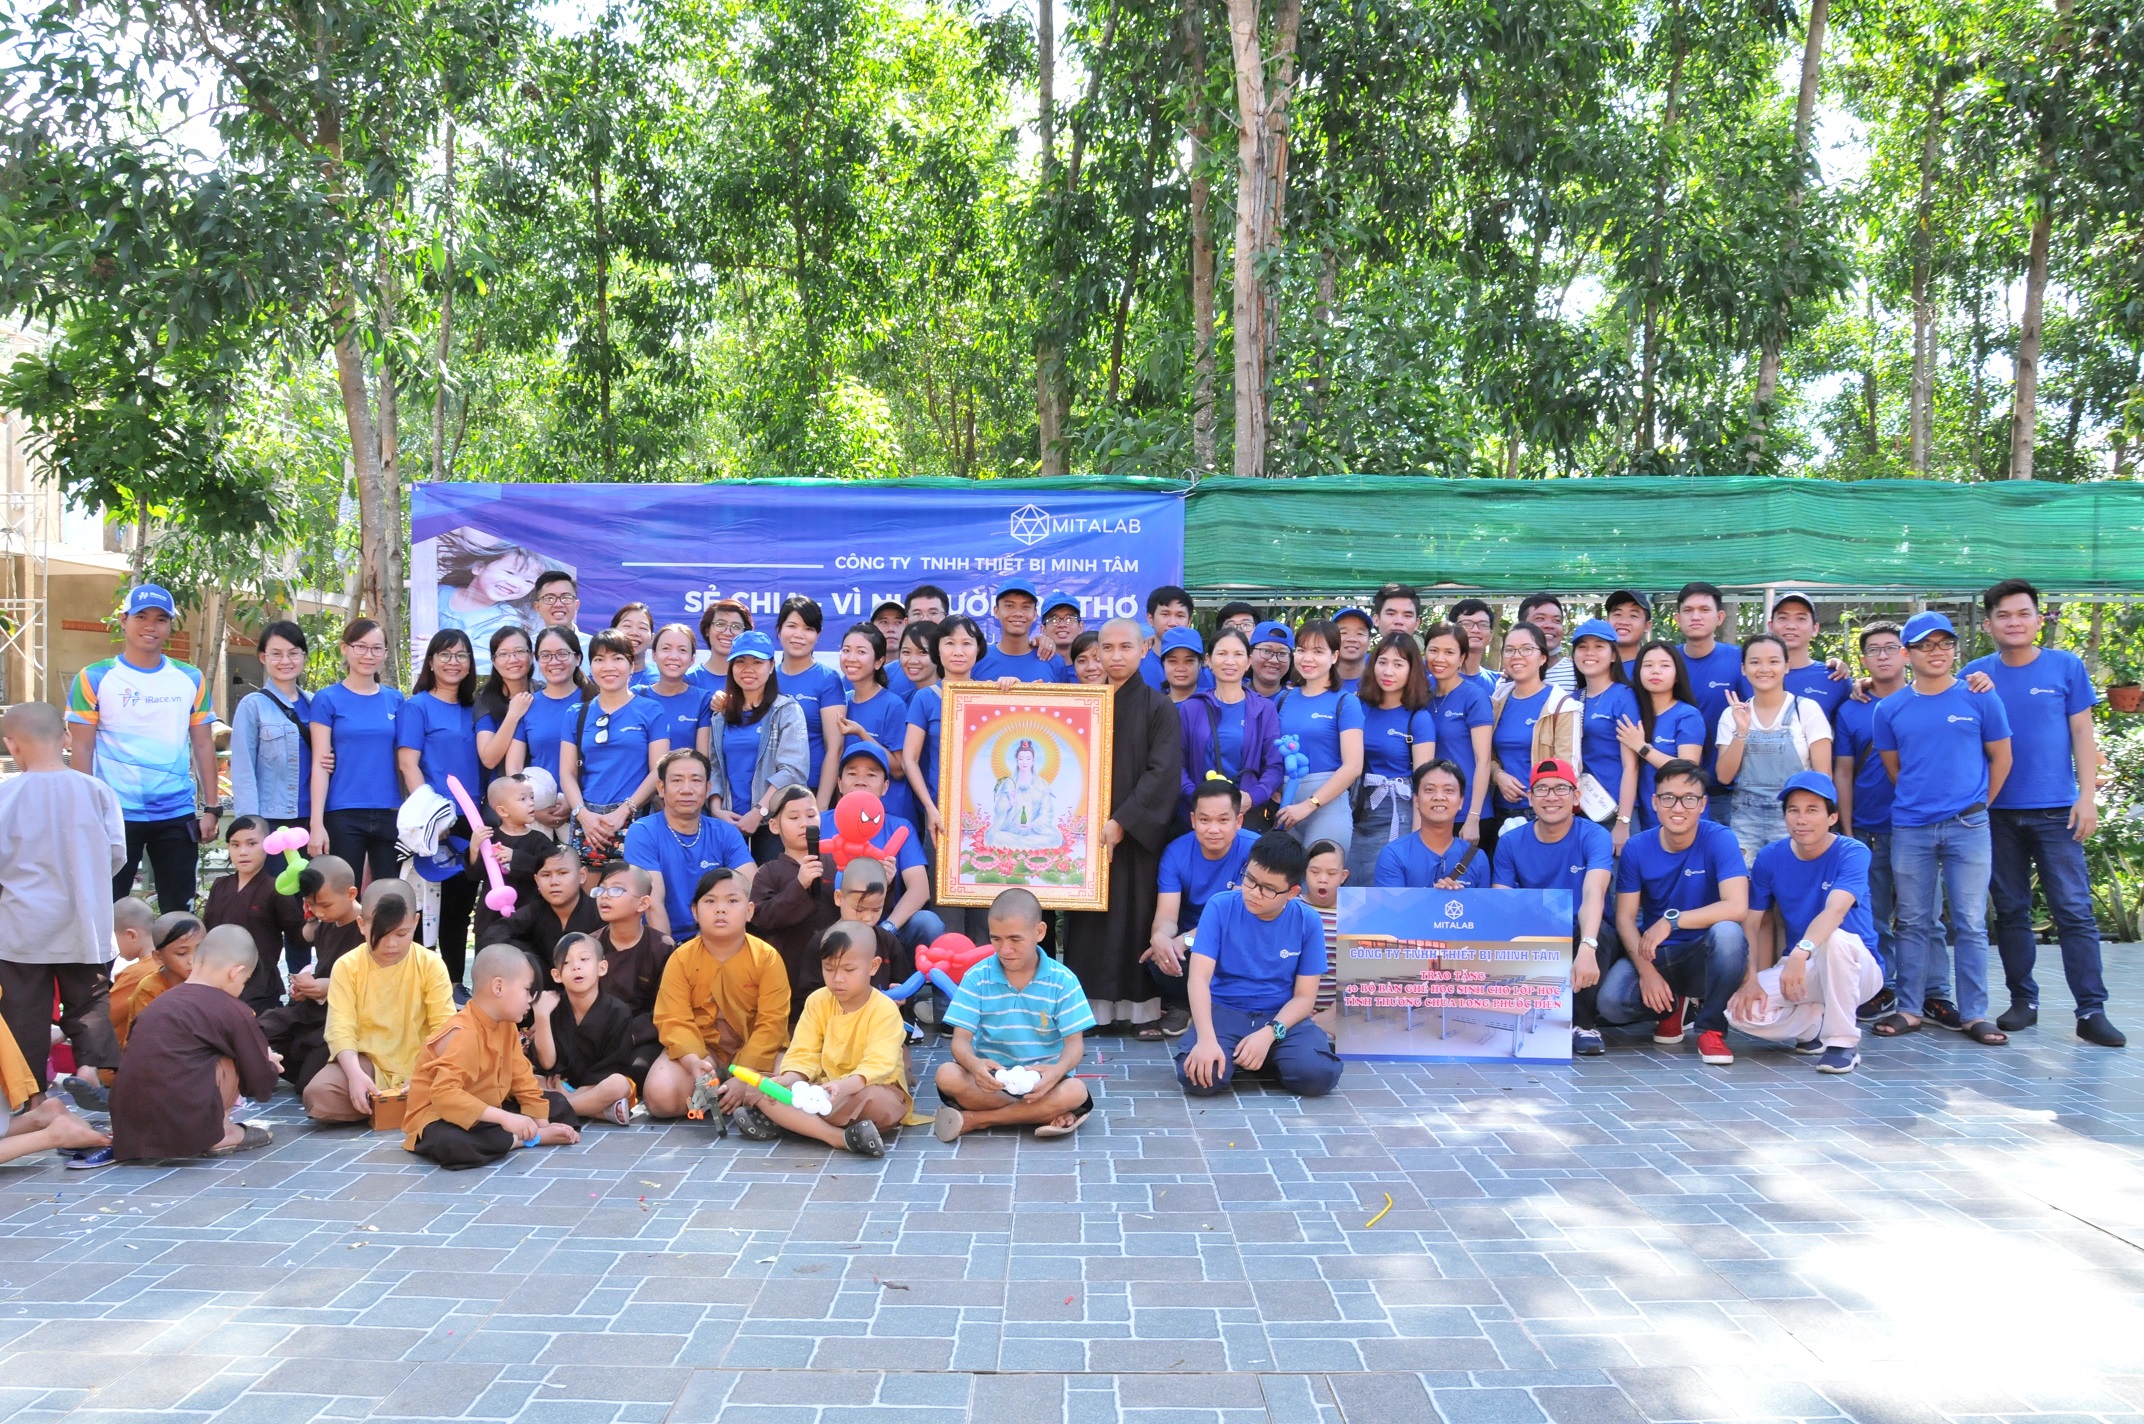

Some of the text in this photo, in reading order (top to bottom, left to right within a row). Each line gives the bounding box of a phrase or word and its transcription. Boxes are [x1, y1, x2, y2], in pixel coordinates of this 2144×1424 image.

[1052, 518, 1141, 534] MITALAB
[835, 552, 1139, 575] CÔNG TY TNHH THIẾT BỊ MINH TÂM
[831, 587, 861, 615] VÌ
[1076, 594, 1139, 619] THƠ
[145, 695, 182, 704] iRace.vn
[1433, 921, 1475, 930] MITALAB
[1350, 946, 1560, 962] CÔNG TY TNHH THIẾT BỊ MINH TÂM
[1420, 969, 1487, 983] TRAO TẶNG
[1345, 984, 1358, 993] 40
[1360, 981, 1376, 995] BỘ
[1378, 981, 1402, 993] BÀN
[1456, 984, 1485, 995] SINH
[1487, 984, 1511, 995] CHO
